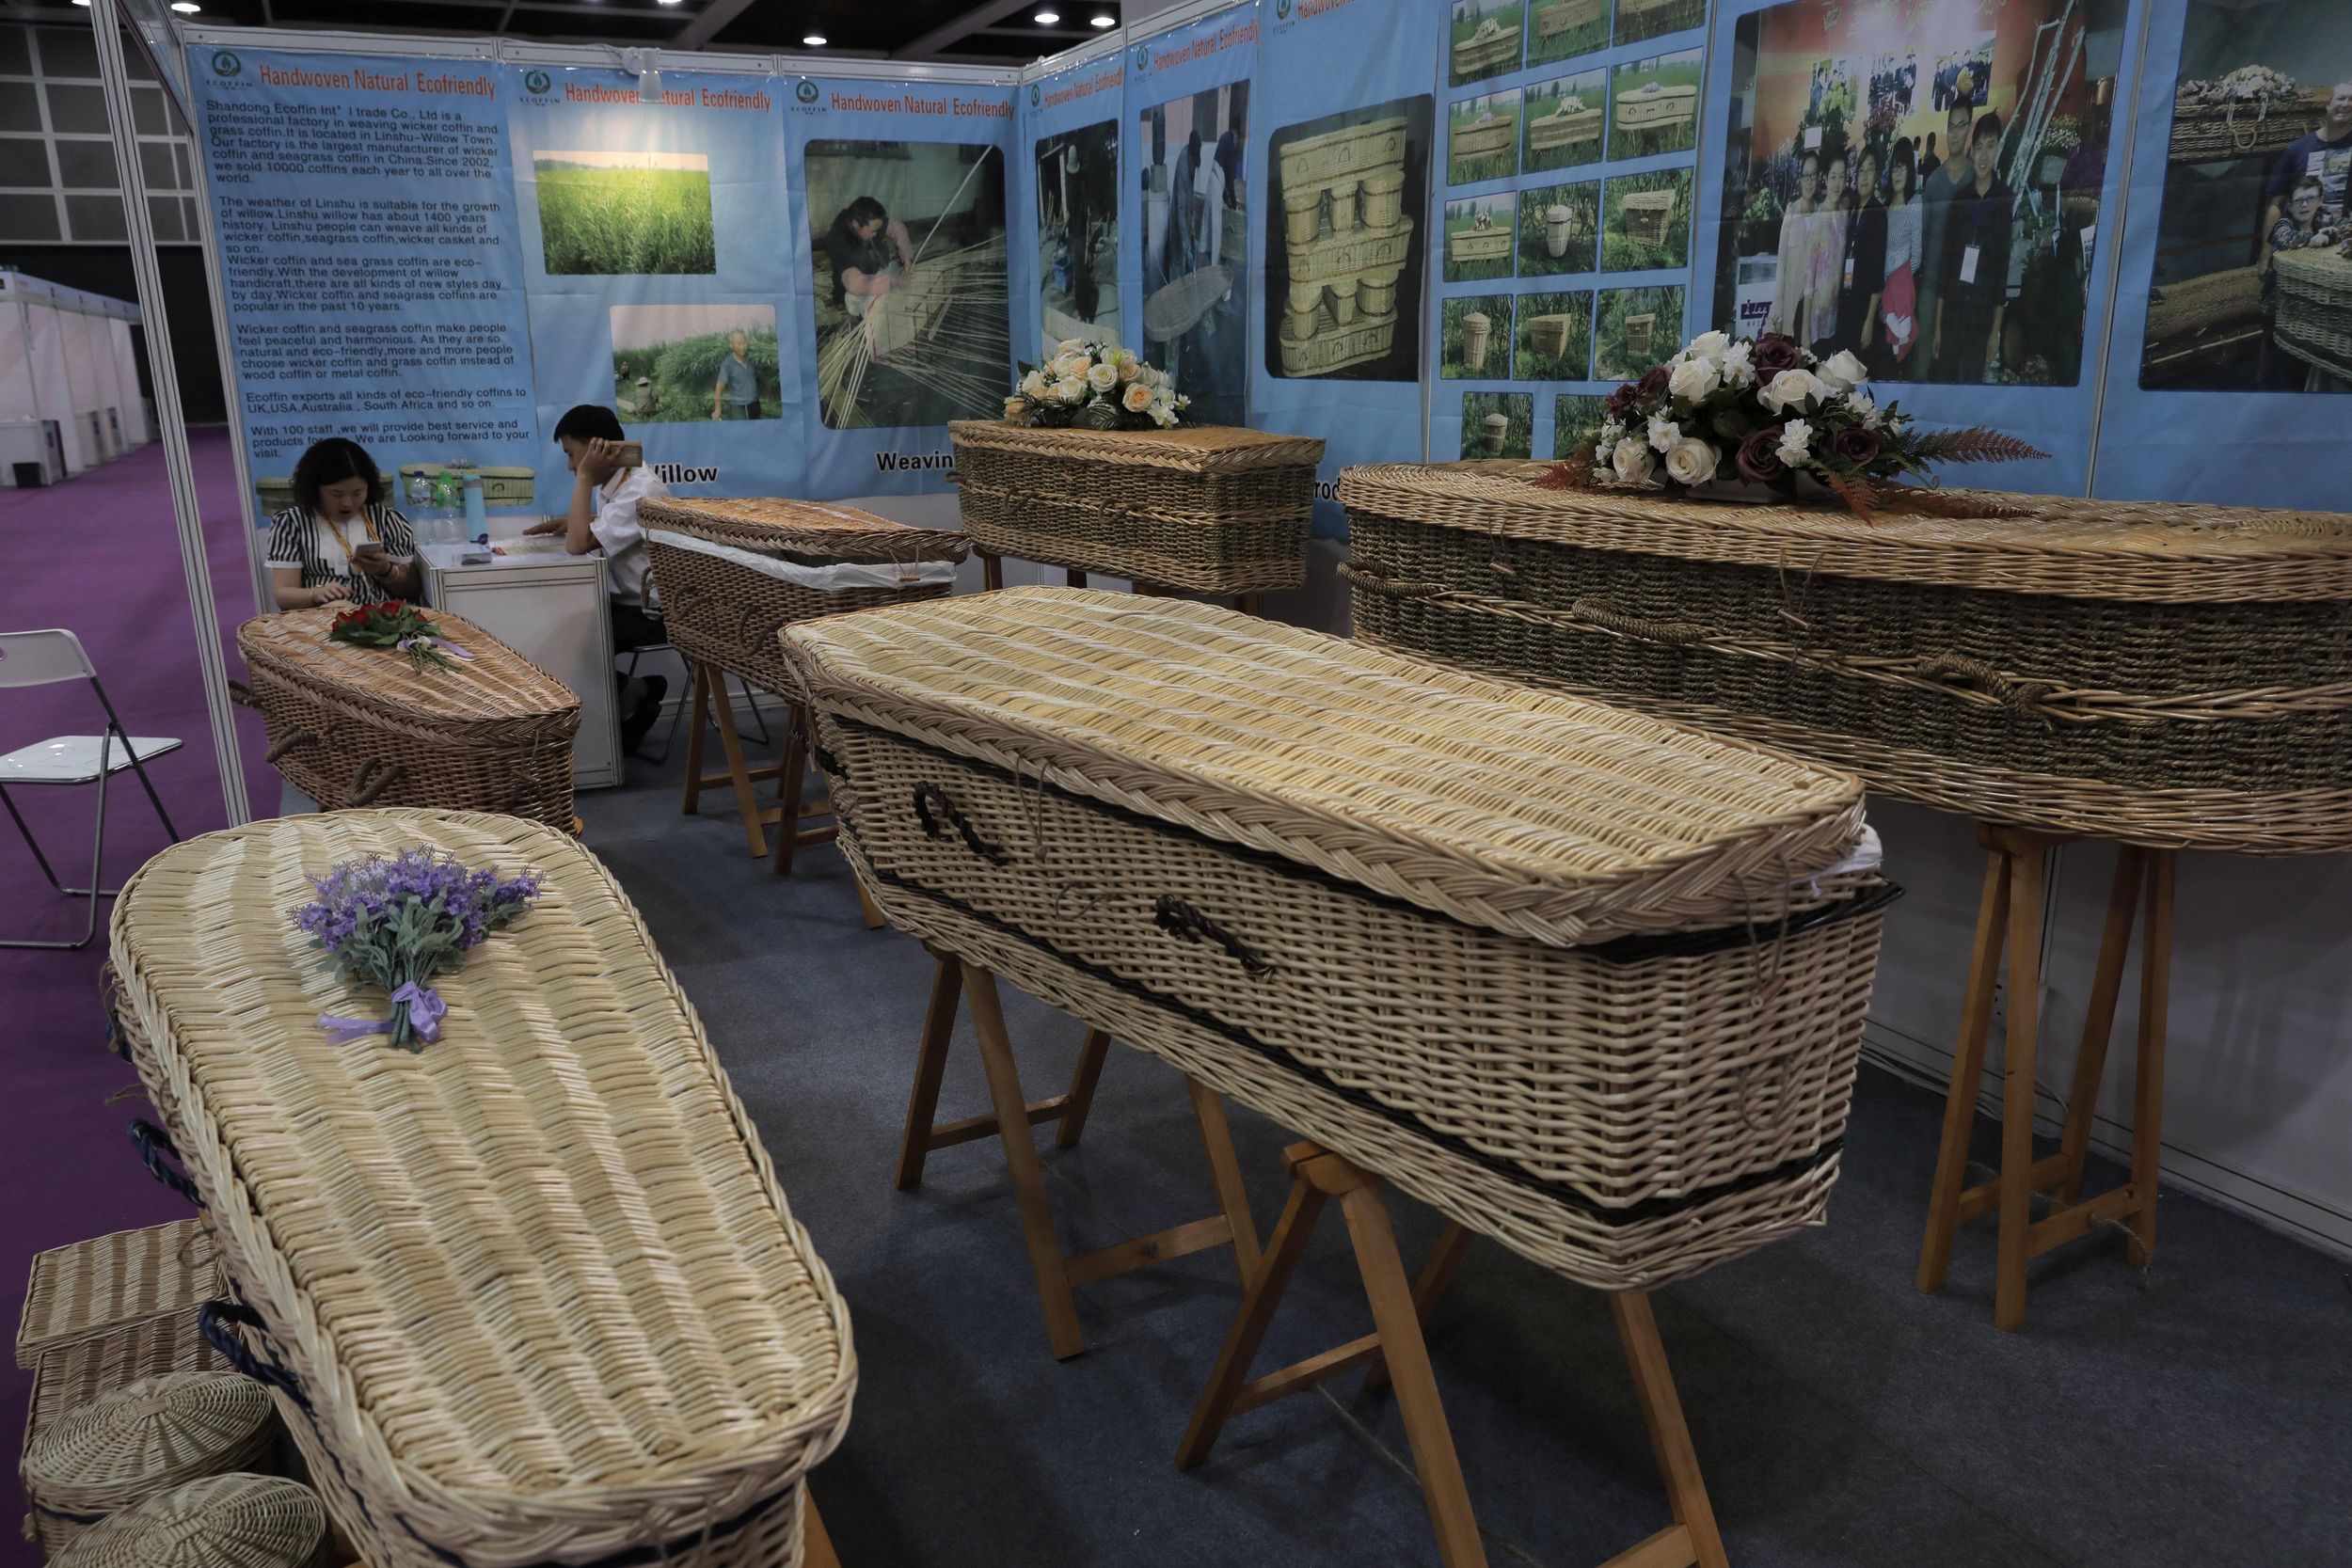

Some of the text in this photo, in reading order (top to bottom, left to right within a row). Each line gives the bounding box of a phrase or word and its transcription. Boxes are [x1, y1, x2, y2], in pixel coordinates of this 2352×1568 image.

[1154, 47, 1190, 71] Handwoven
[1192, 33, 1216, 59] Natural
[260, 64, 495, 100] Handwoven Natural Ecofriendly
[702, 88, 771, 113] Ecofriendly
[832, 92, 900, 113] Handwoven
[904, 95, 946, 115] Natural
[954, 98, 1014, 121] Ecofriendly
[206, 101, 387, 118] Shandong Ecoffin trade
[208, 114, 473, 133] professional factory weaving wicker coffin
[210, 128, 244, 138] grass
[312, 129, 356, 139] located
[239, 137, 498, 156] factory the largest manufacturer wicker
[213, 150, 370, 164] coffin and seagrass coffin
[237, 162, 262, 171] sold
[267, 163, 304, 173] 10000
[309, 164, 347, 174] coffins
[352, 166, 380, 175] each
[384, 168, 408, 178] year
[429, 167, 441, 177] all
[474, 168, 491, 178] the
[219, 197, 500, 214] The weather Linshu suitable for the growth
[323, 211, 486, 225] willow has about 1400 years
[272, 221, 312, 231] Linshu
[316, 222, 356, 234] people
[426, 223, 439, 233] all
[443, 224, 472, 233] kinds
[225, 231, 499, 245] wicker casket and
[227, 255, 269, 265] Wicker
[273, 256, 307, 265] coffin
[310, 256, 333, 265] and
[362, 259, 393, 268] grass
[397, 257, 429, 266] coffin
[310, 267, 459, 279] the development willow
[354, 278, 366, 288] all
[371, 278, 401, 289] kinds
[446, 279, 478, 292] styles
[482, 279, 501, 292] day
[322, 290, 354, 299] coffin
[358, 290, 379, 299] and
[383, 292, 435, 302] seagrass
[438, 290, 475, 299] coffins
[233, 301, 279, 313] popular
[298, 301, 317, 310] the
[321, 301, 346, 313] past
[236, 323, 506, 336] Wicker coffin and seagrass coffin make people
[238, 336, 261, 345] feel
[265, 335, 316, 348] peaceful
[320, 335, 342, 344] and
[438, 334, 462, 346] they
[240, 347, 281, 356] natural
[286, 347, 308, 356] and
[420, 345, 440, 355] and
[476, 344, 512, 356] people
[242, 356, 501, 369] choose wicker coffin and grass coffin instead
[243, 370, 275, 379] wood
[278, 369, 311, 379] coffin
[332, 368, 363, 378] metal
[246, 388, 512, 404] Ecoffin exports all kinds coffins
[364, 399, 457, 411] South Africa and
[251, 419, 517, 436] With staff will provide best service and
[252, 430, 529, 449] products for are Looking forward your
[876, 450, 953, 470] Weavin
[1315, 478, 1341, 500] rod
